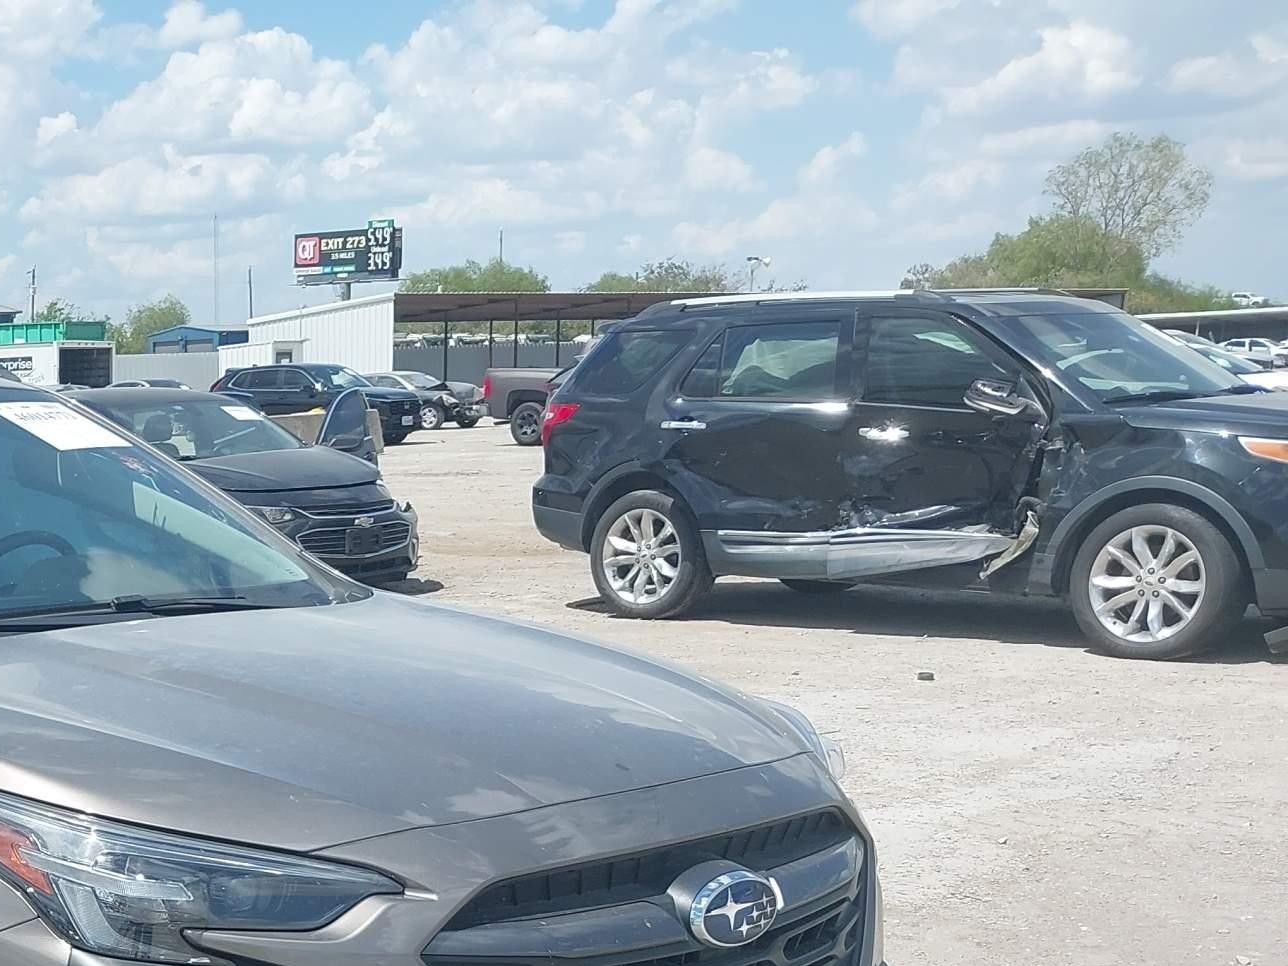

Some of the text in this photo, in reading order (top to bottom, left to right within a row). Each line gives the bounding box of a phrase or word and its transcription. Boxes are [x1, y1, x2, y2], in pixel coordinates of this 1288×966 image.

[298, 241, 317, 260] QT
[321, 236, 366, 251] EXIT 273
